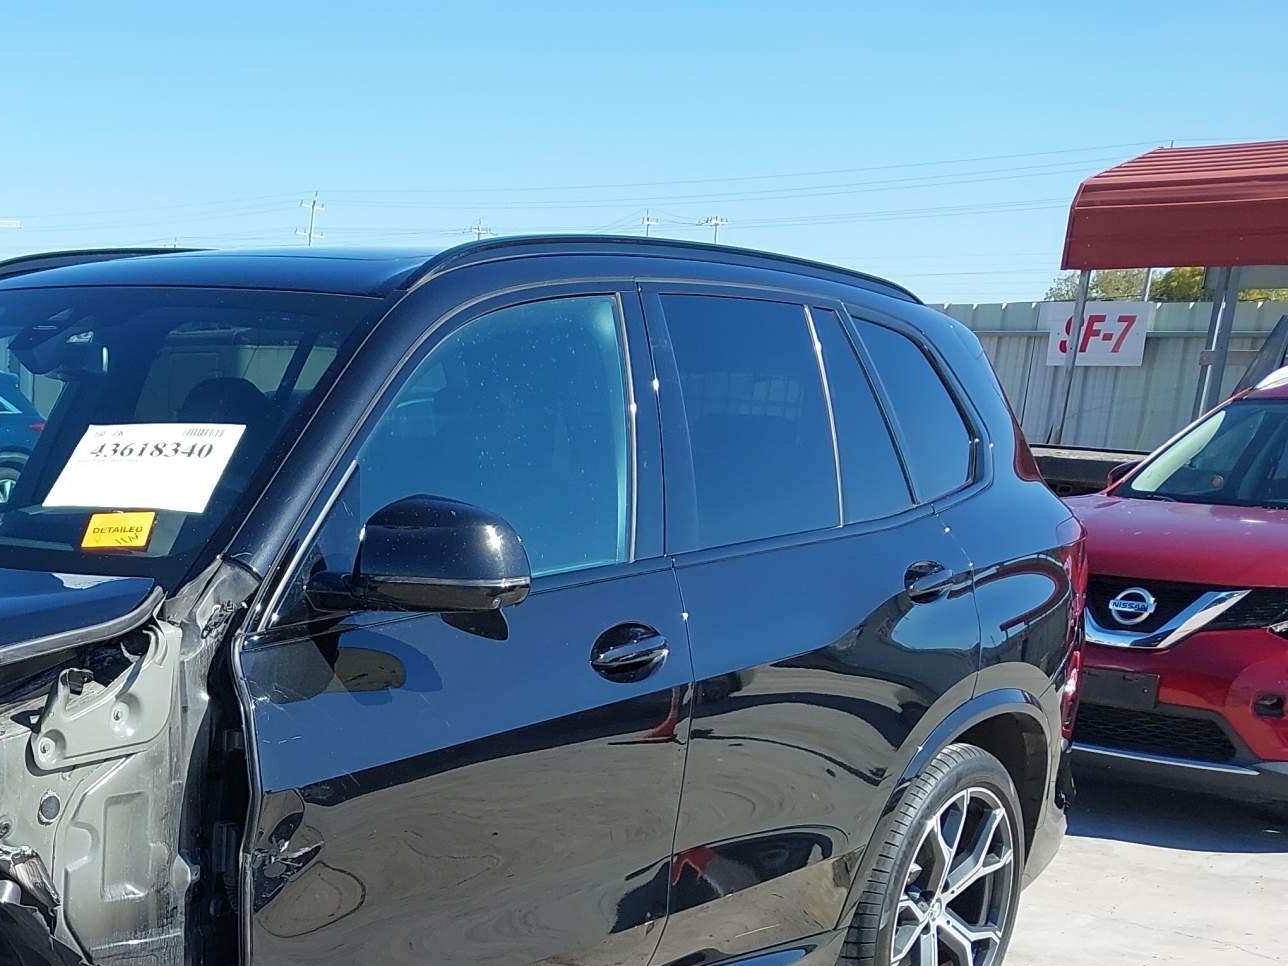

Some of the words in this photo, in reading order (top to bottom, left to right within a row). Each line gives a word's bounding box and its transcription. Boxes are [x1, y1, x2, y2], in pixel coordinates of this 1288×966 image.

[90, 440, 214, 459] 43618340
[92, 526, 144, 535] DETAILED
[1112, 601, 1149, 611] NISSAN
